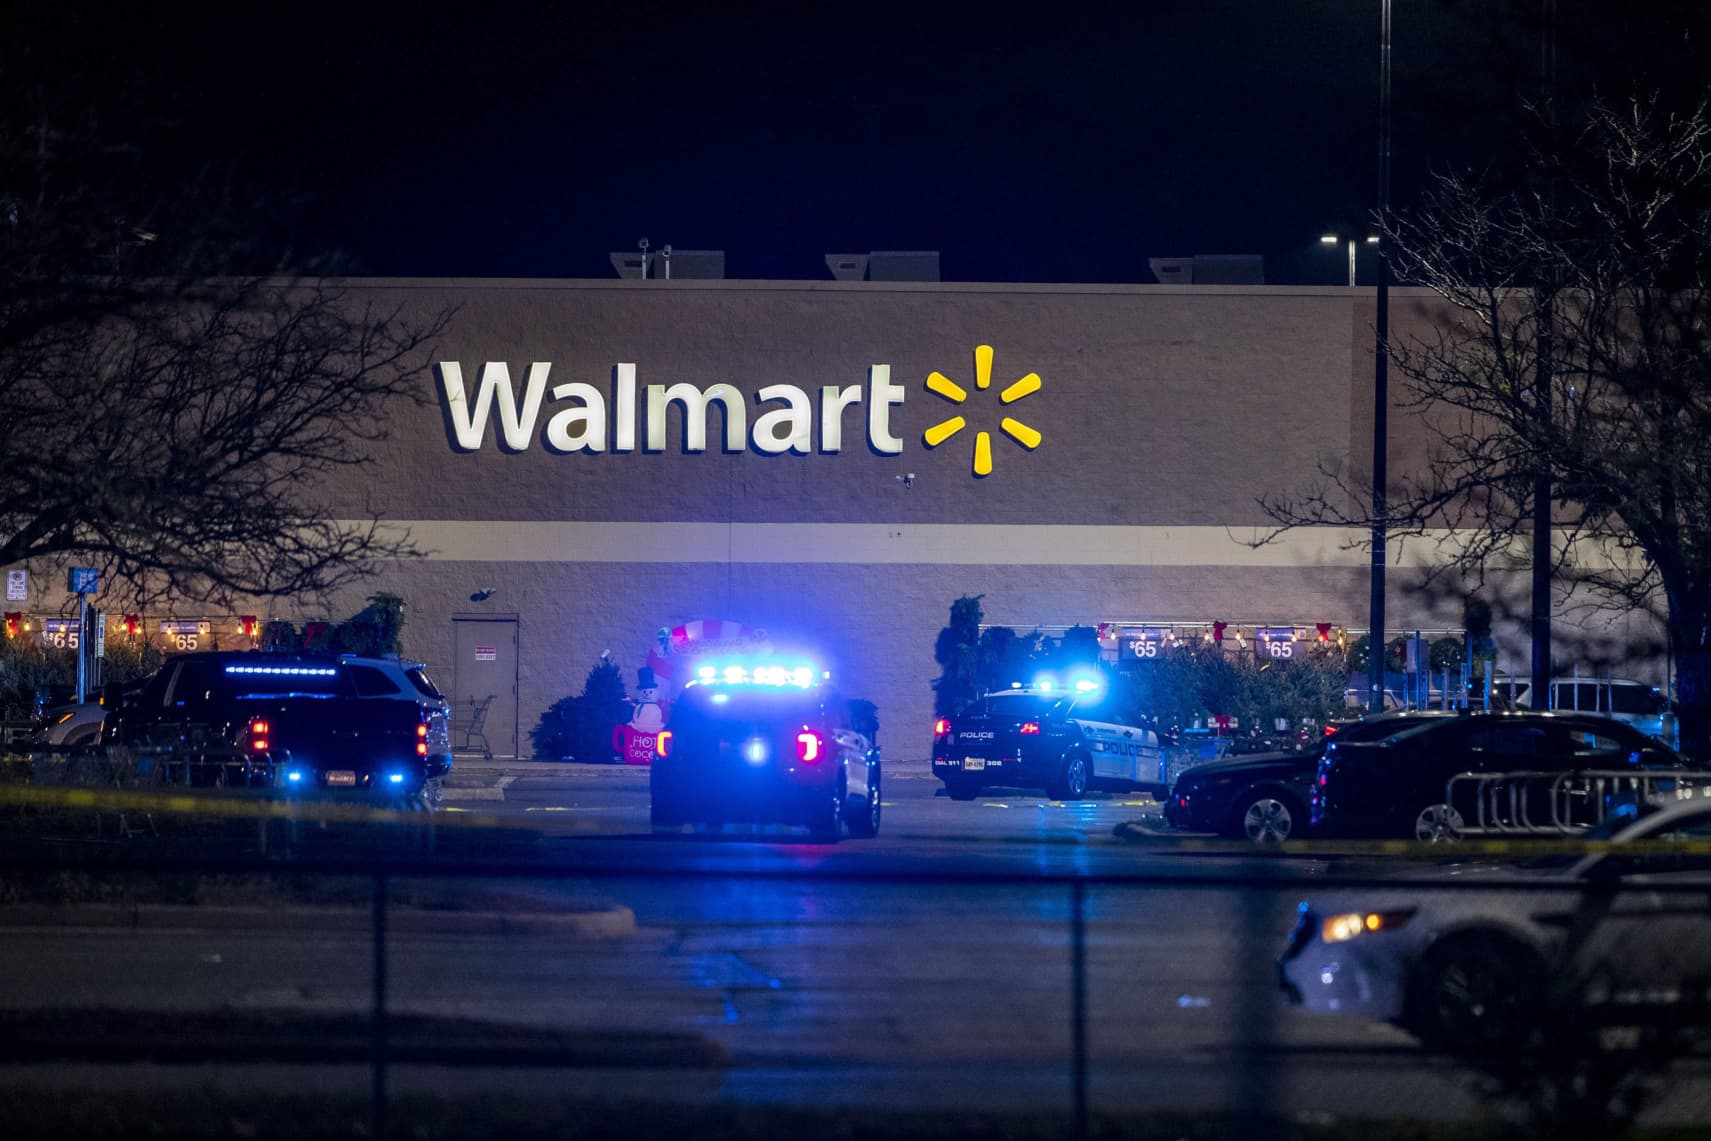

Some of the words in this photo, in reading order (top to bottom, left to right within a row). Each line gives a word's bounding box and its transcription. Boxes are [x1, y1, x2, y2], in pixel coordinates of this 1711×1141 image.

[439, 361, 905, 453] Walmart
[48, 632, 79, 649] $65
[1129, 641, 1157, 658] $65
[1265, 641, 1293, 658] $65
[960, 731, 994, 739] POLICE
